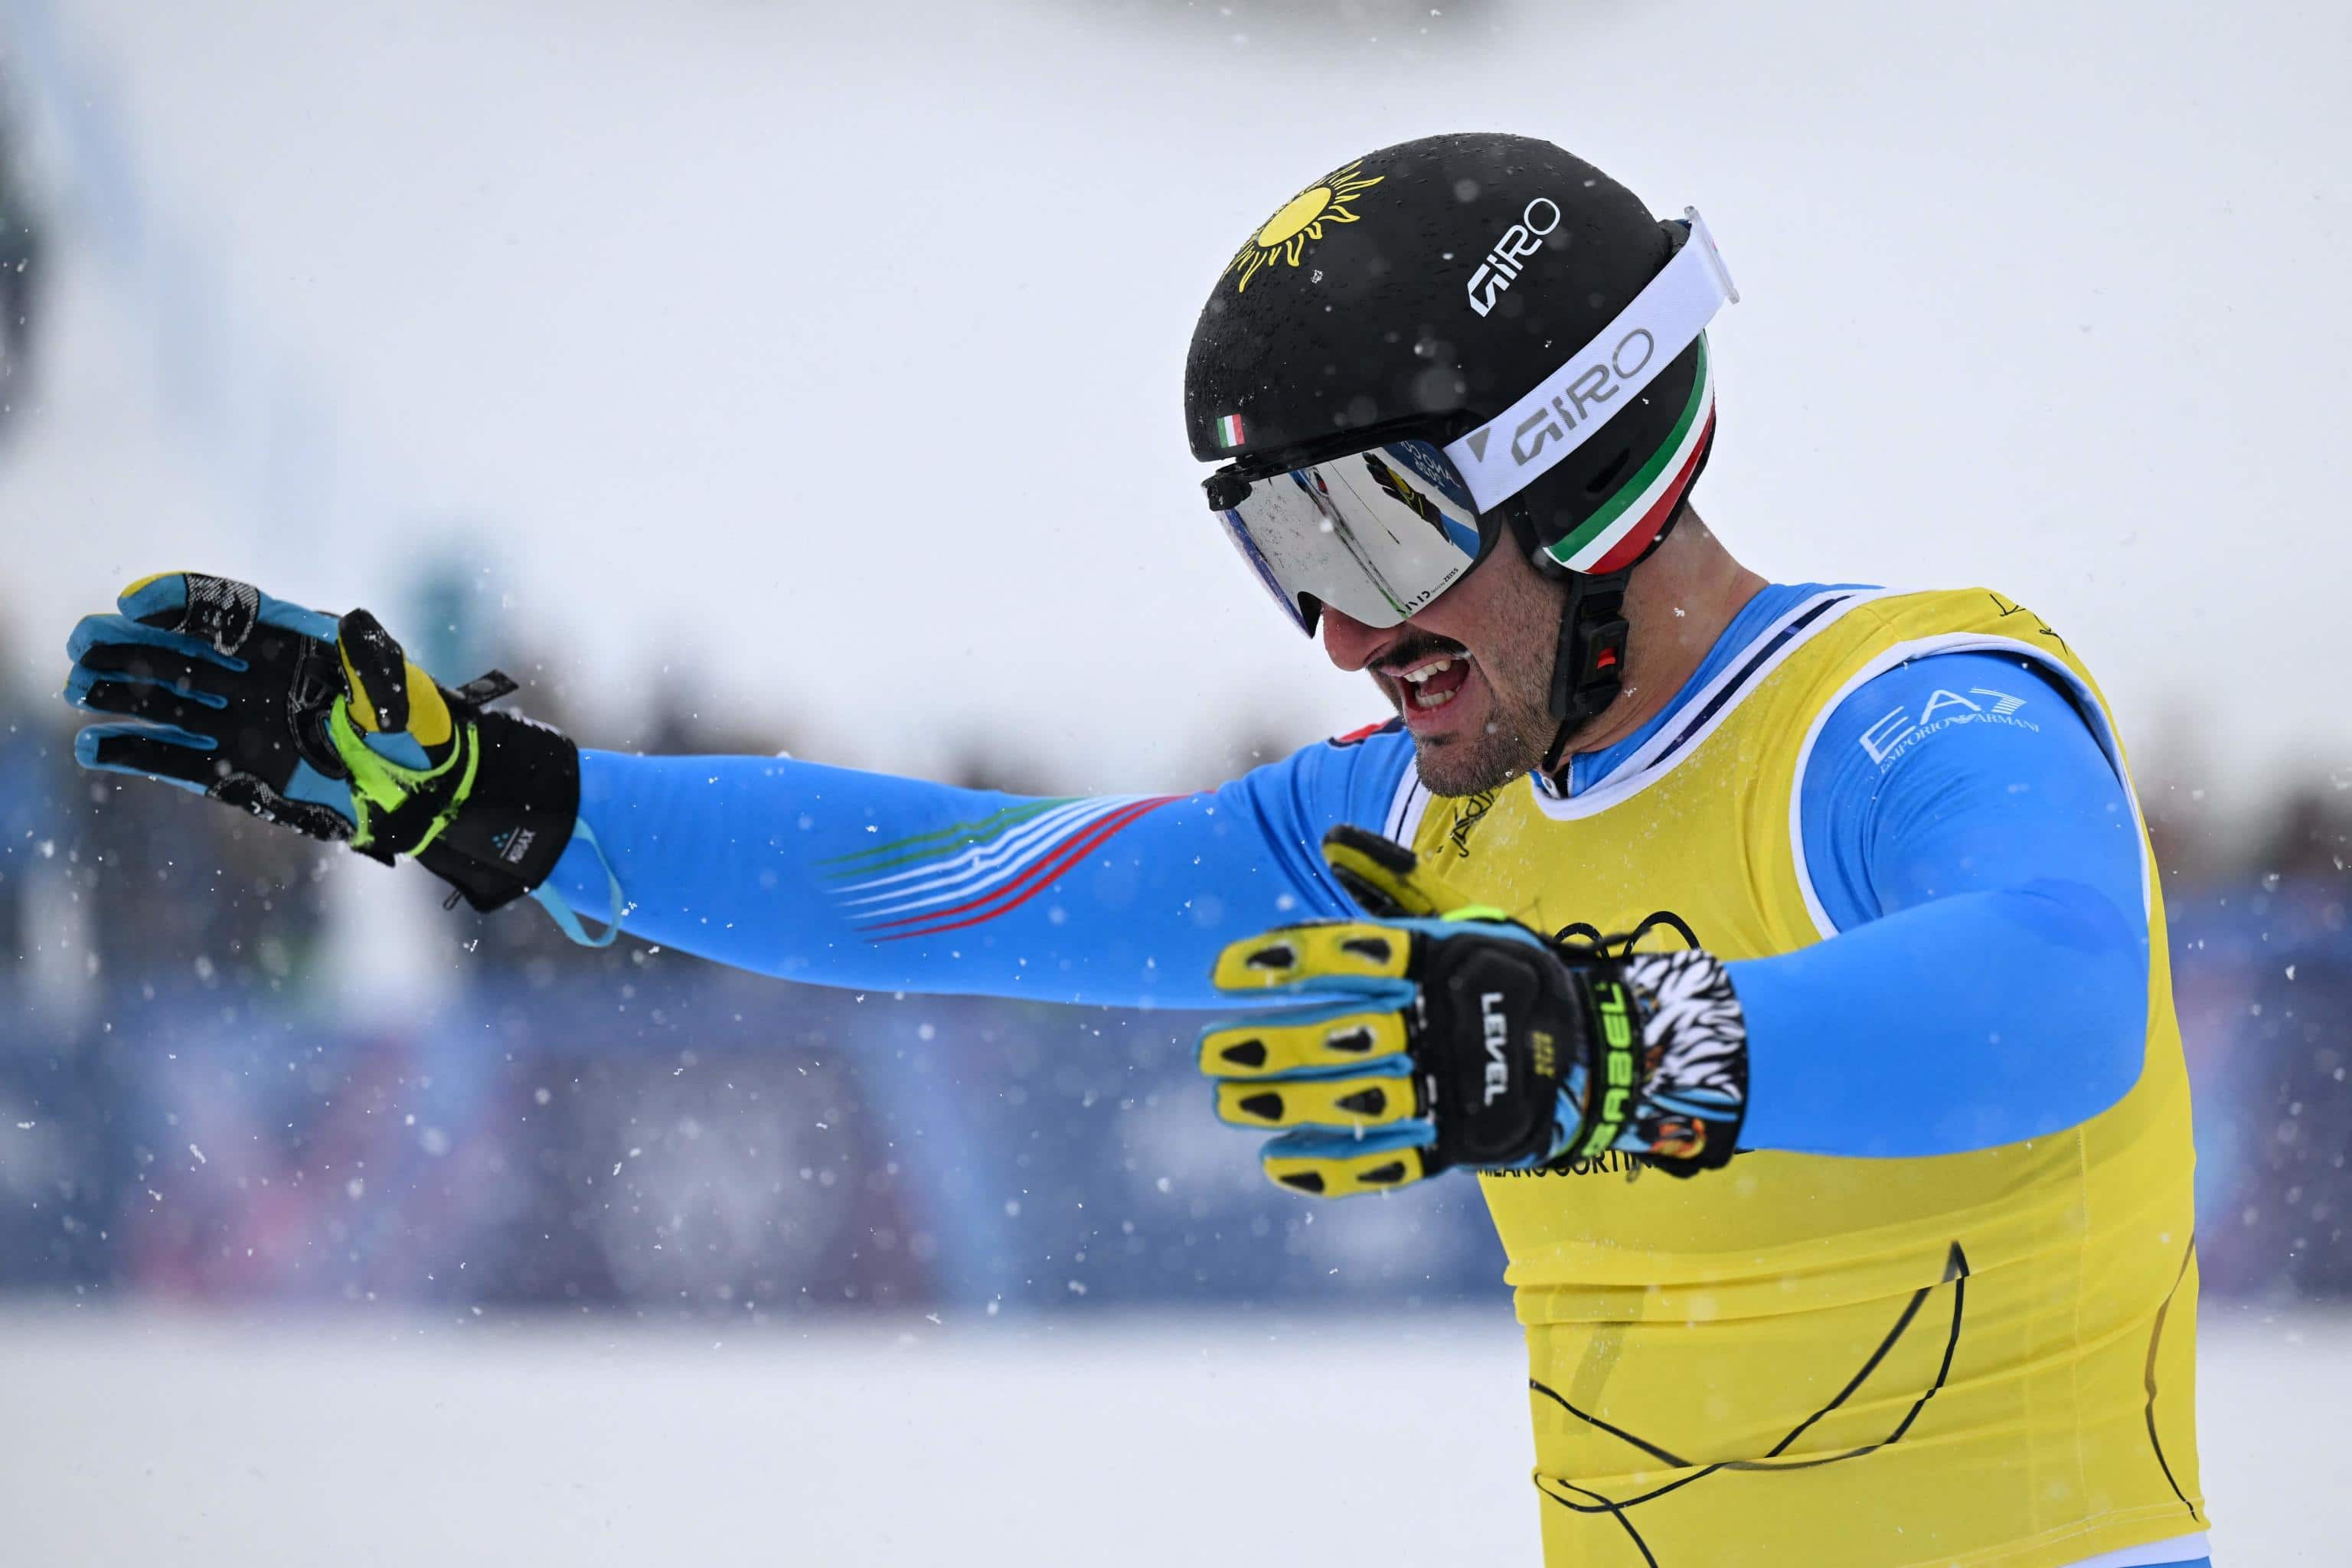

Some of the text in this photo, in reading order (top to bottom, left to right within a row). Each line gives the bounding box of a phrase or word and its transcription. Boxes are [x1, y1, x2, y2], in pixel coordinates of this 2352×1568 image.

[1467, 198, 1561, 318] GIRO
[1511, 328, 1655, 466] GIRO
[1443, 567, 1459, 583] ZEISS
[1860, 688, 2027, 765] EA7
[1880, 712, 2040, 774] EMPORIO ARMANI
[1481, 992, 1508, 1107] LEVEL
